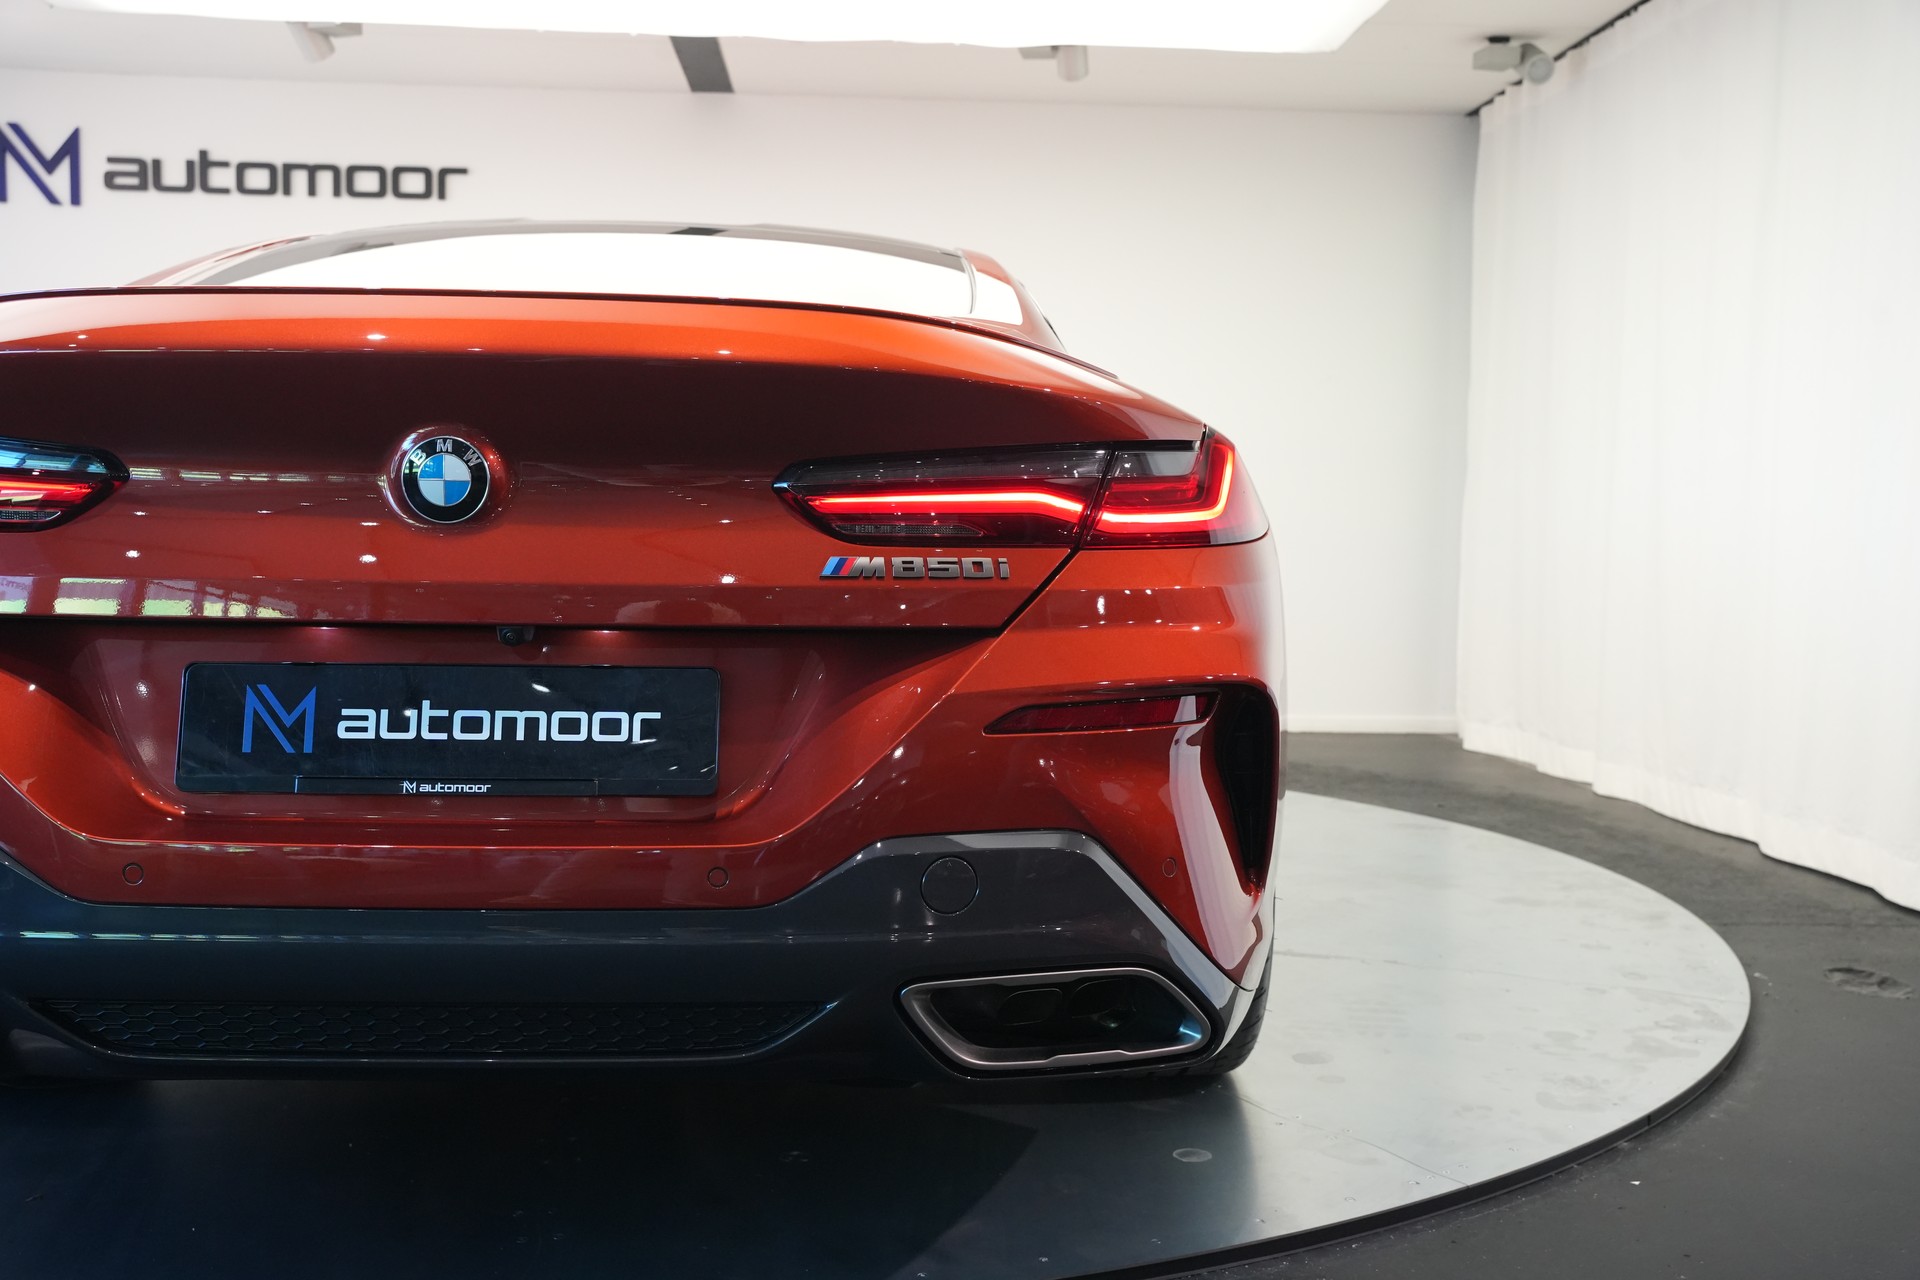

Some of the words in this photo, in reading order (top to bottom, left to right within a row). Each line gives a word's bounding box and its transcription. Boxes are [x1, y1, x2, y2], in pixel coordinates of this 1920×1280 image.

[103, 149, 468, 200] automoor
[410, 439, 483, 467] BMW
[336, 699, 662, 743] automoor
[419, 782, 492, 793] automoor
